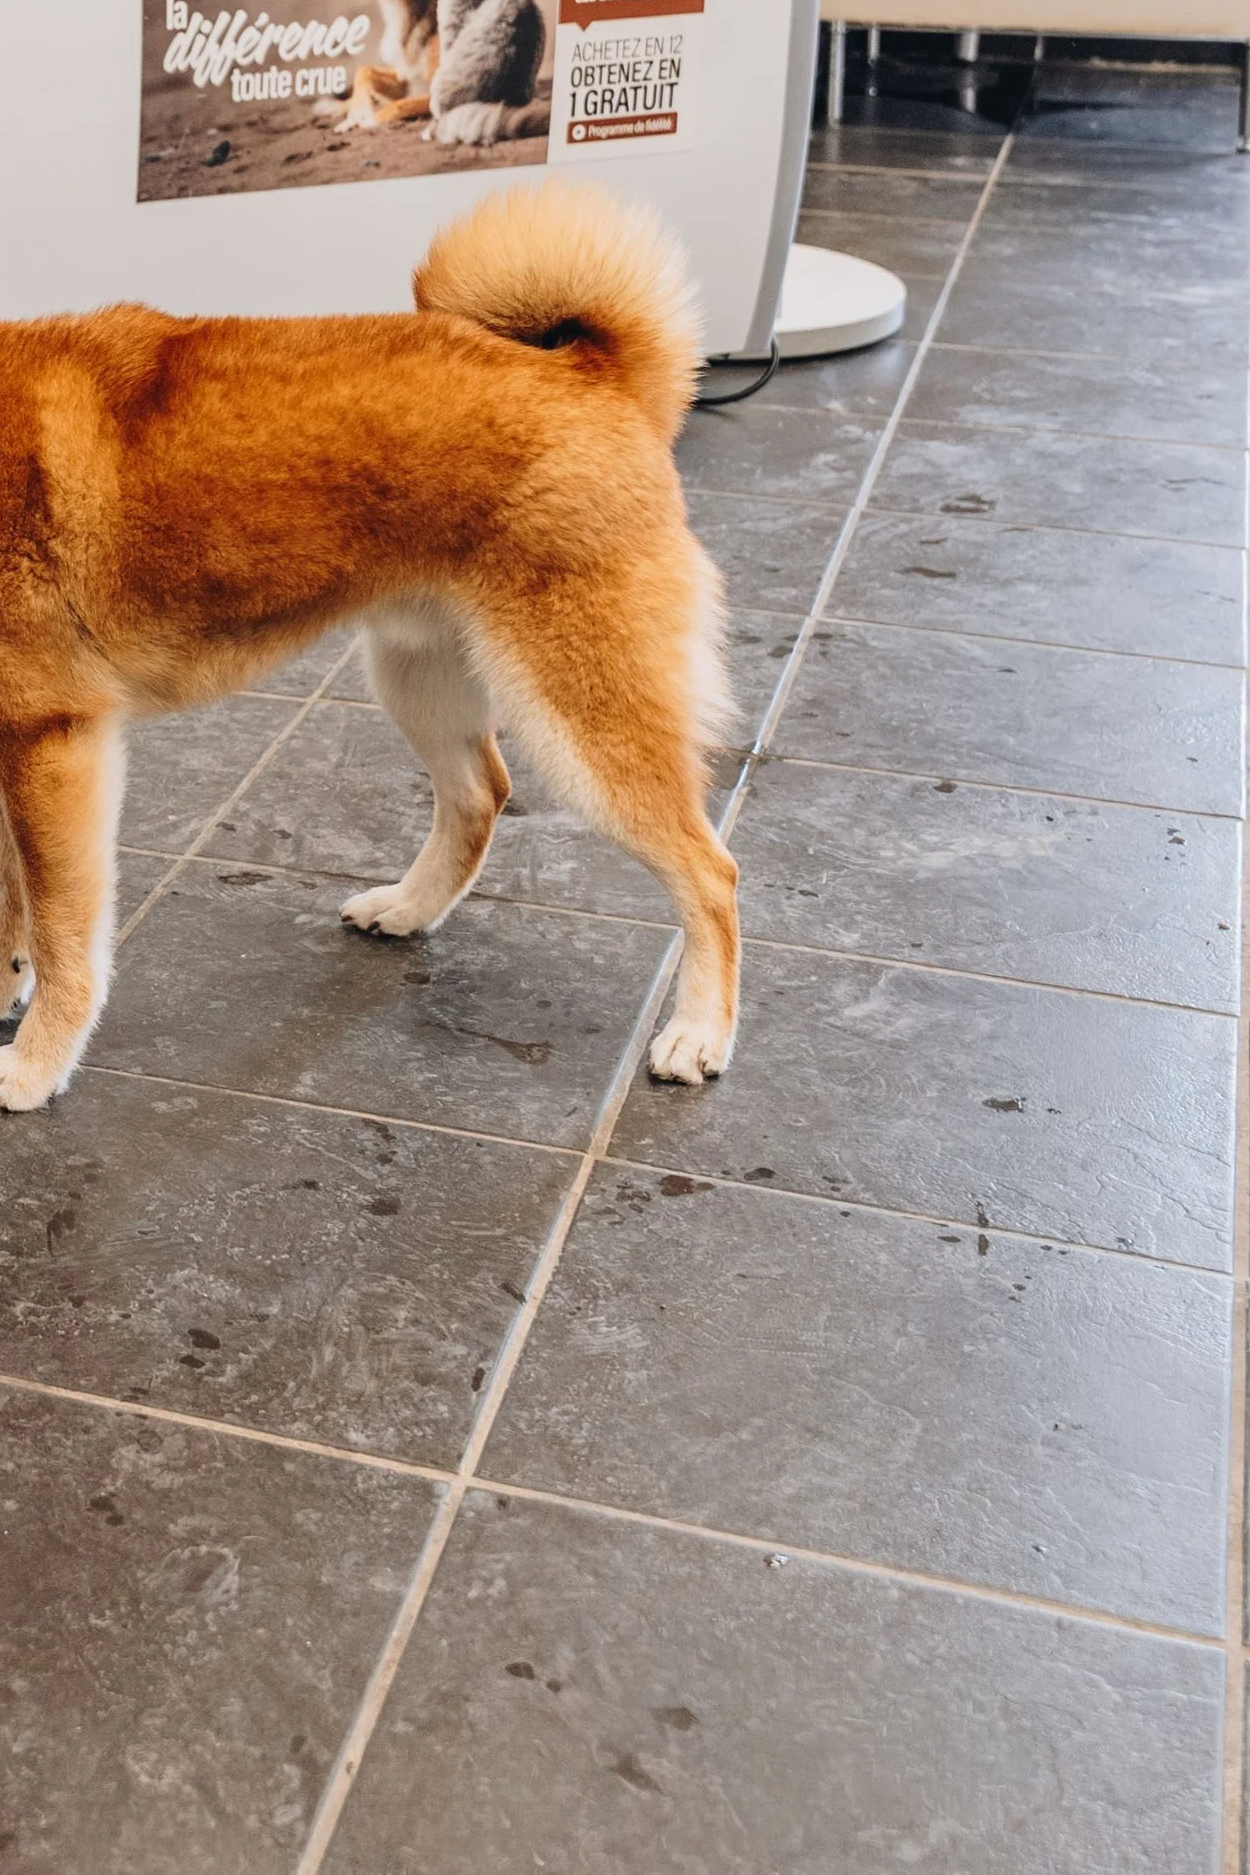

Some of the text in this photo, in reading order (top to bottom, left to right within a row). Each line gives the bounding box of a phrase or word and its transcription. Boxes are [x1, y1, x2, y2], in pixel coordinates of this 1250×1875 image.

[163, 9, 371, 88] différence
[571, 33, 684, 63] ACHETEZ EN 12
[229, 63, 348, 103] toute crue
[570, 57, 682, 89] OBTENEZ EN
[569, 81, 680, 118] 1 GRATUIT
[587, 121, 634, 141] Programme
[634, 119, 645, 135] de
